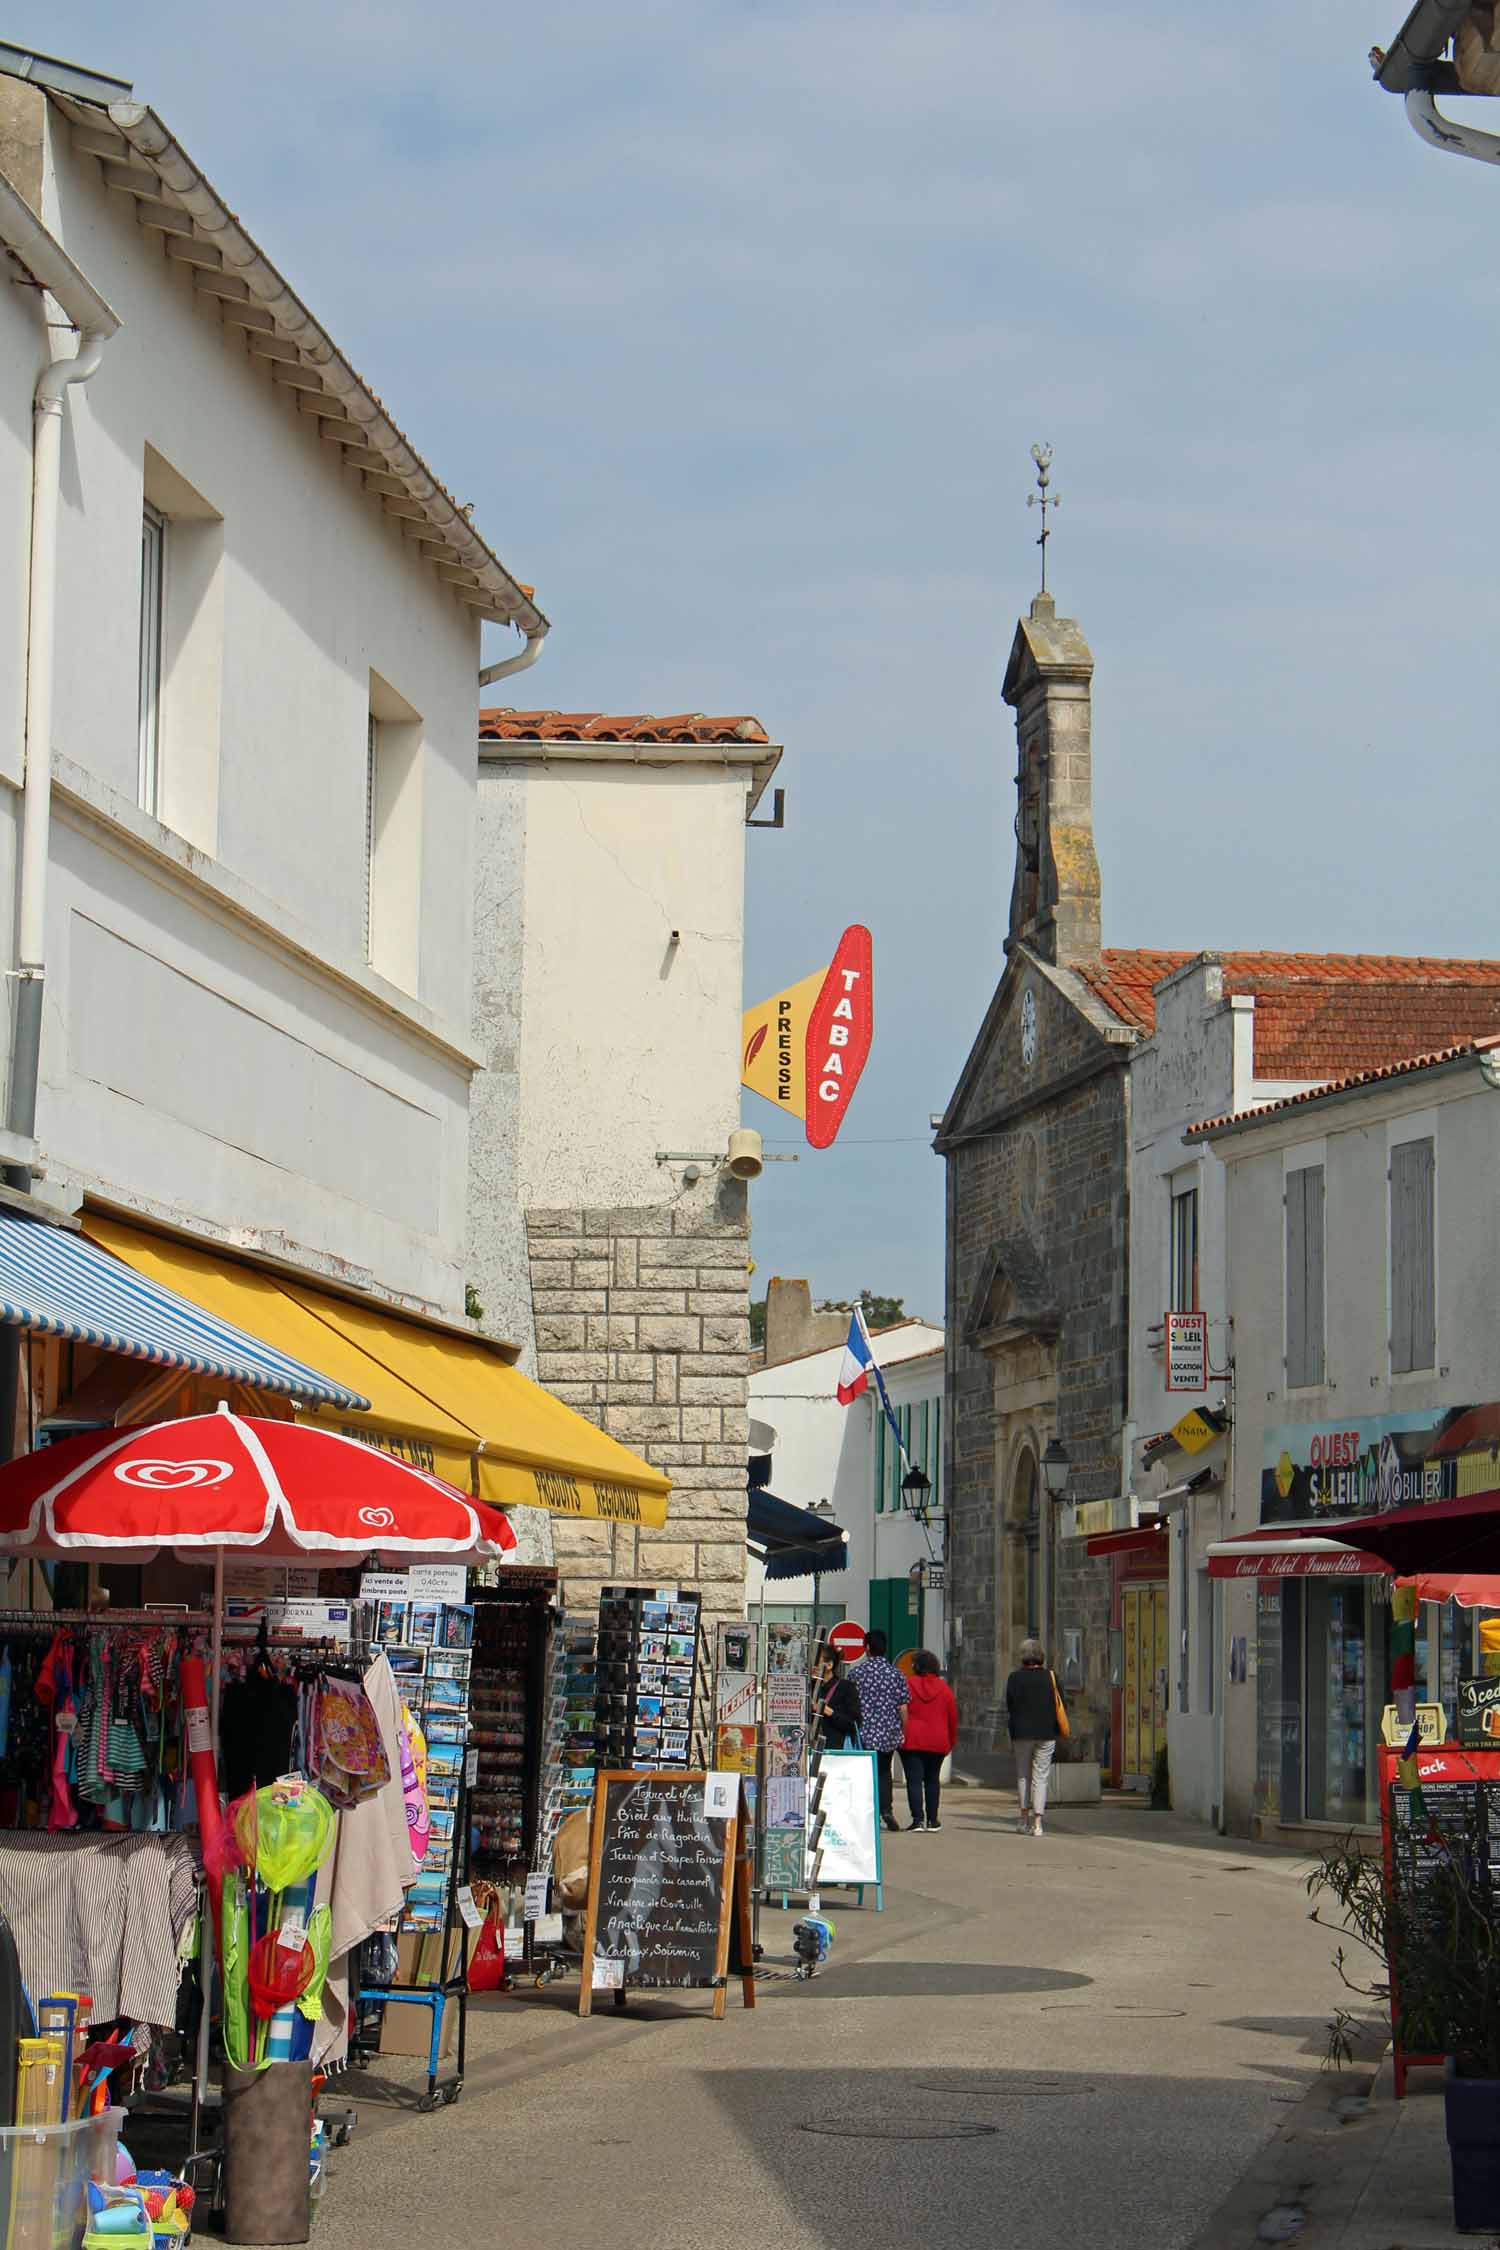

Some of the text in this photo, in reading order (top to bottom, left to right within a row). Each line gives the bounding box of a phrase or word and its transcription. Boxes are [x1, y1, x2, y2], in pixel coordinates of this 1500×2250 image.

[818, 968, 861, 1102] TABAC
[778, 1000, 792, 1100] PRESSE
[1171, 1318, 1201, 1328] OUEST
[1171, 1363, 1202, 1371] LOCATION
[1174, 1375, 1199, 1383] VENTE
[1310, 1431, 1360, 1468] OUEST
[533, 1471, 581, 1512] PRODUITS
[361, 1587, 407, 1596] timbres poste
[283, 1607, 314, 1617] JOURNAL
[646, 1831, 659, 1840] de
[661, 1829, 711, 1848] Ragondin
